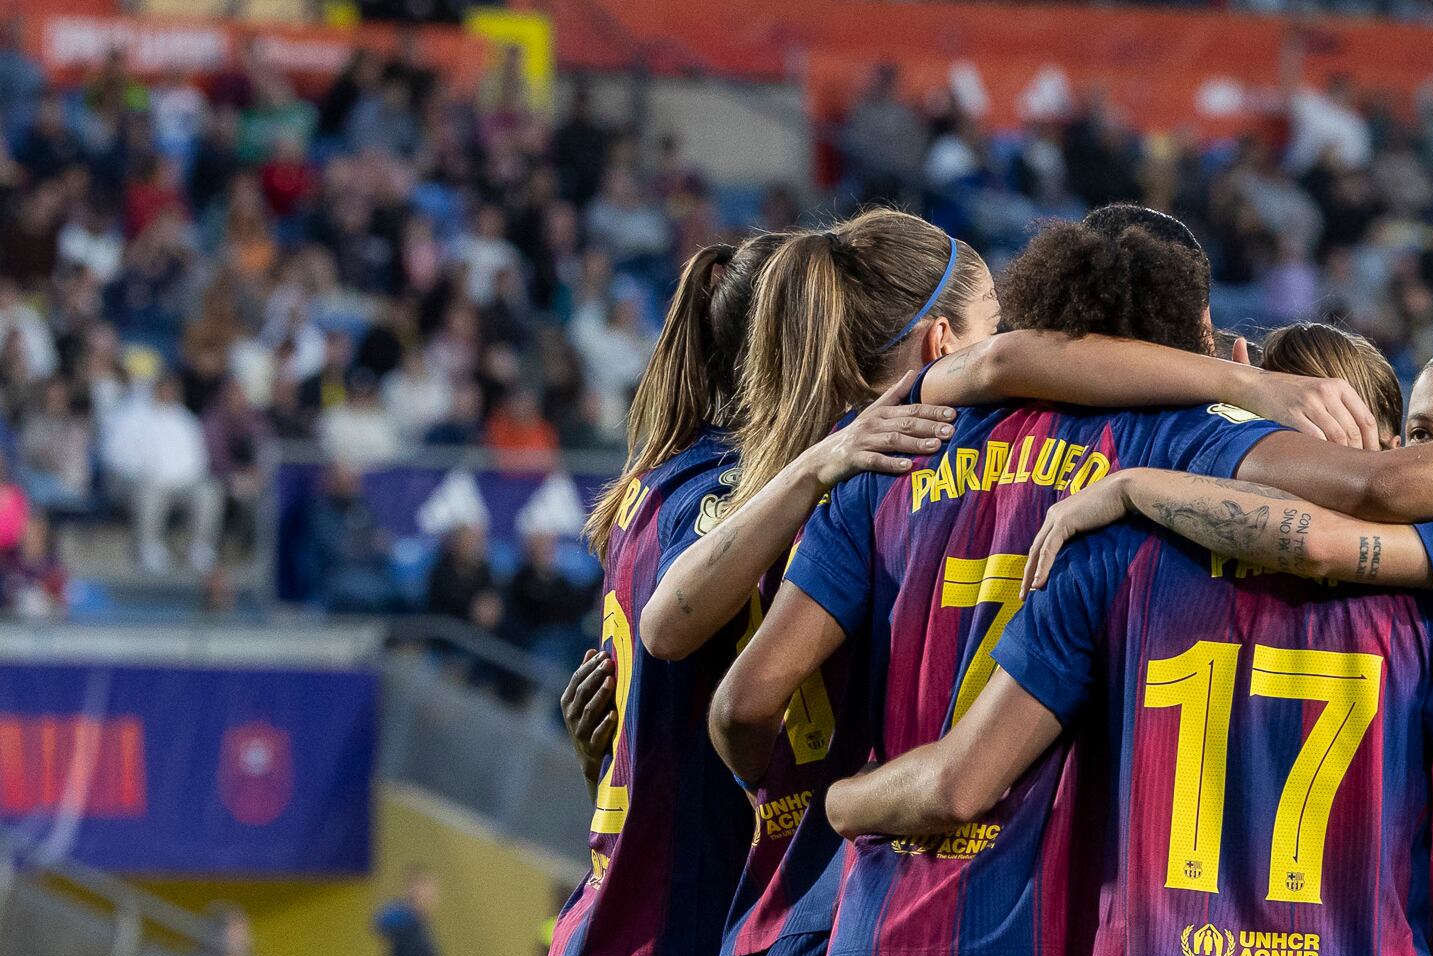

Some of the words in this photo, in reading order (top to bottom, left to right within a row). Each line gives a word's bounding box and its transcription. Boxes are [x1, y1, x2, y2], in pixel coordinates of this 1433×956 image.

[912, 435, 1110, 514] PARALLUEO
[1280, 508, 1297, 534] SINO
[1143, 640, 1385, 904] 17
[760, 790, 813, 820] UNHC
[767, 810, 804, 835] ACN
[1239, 930, 1320, 950] UNHCR
